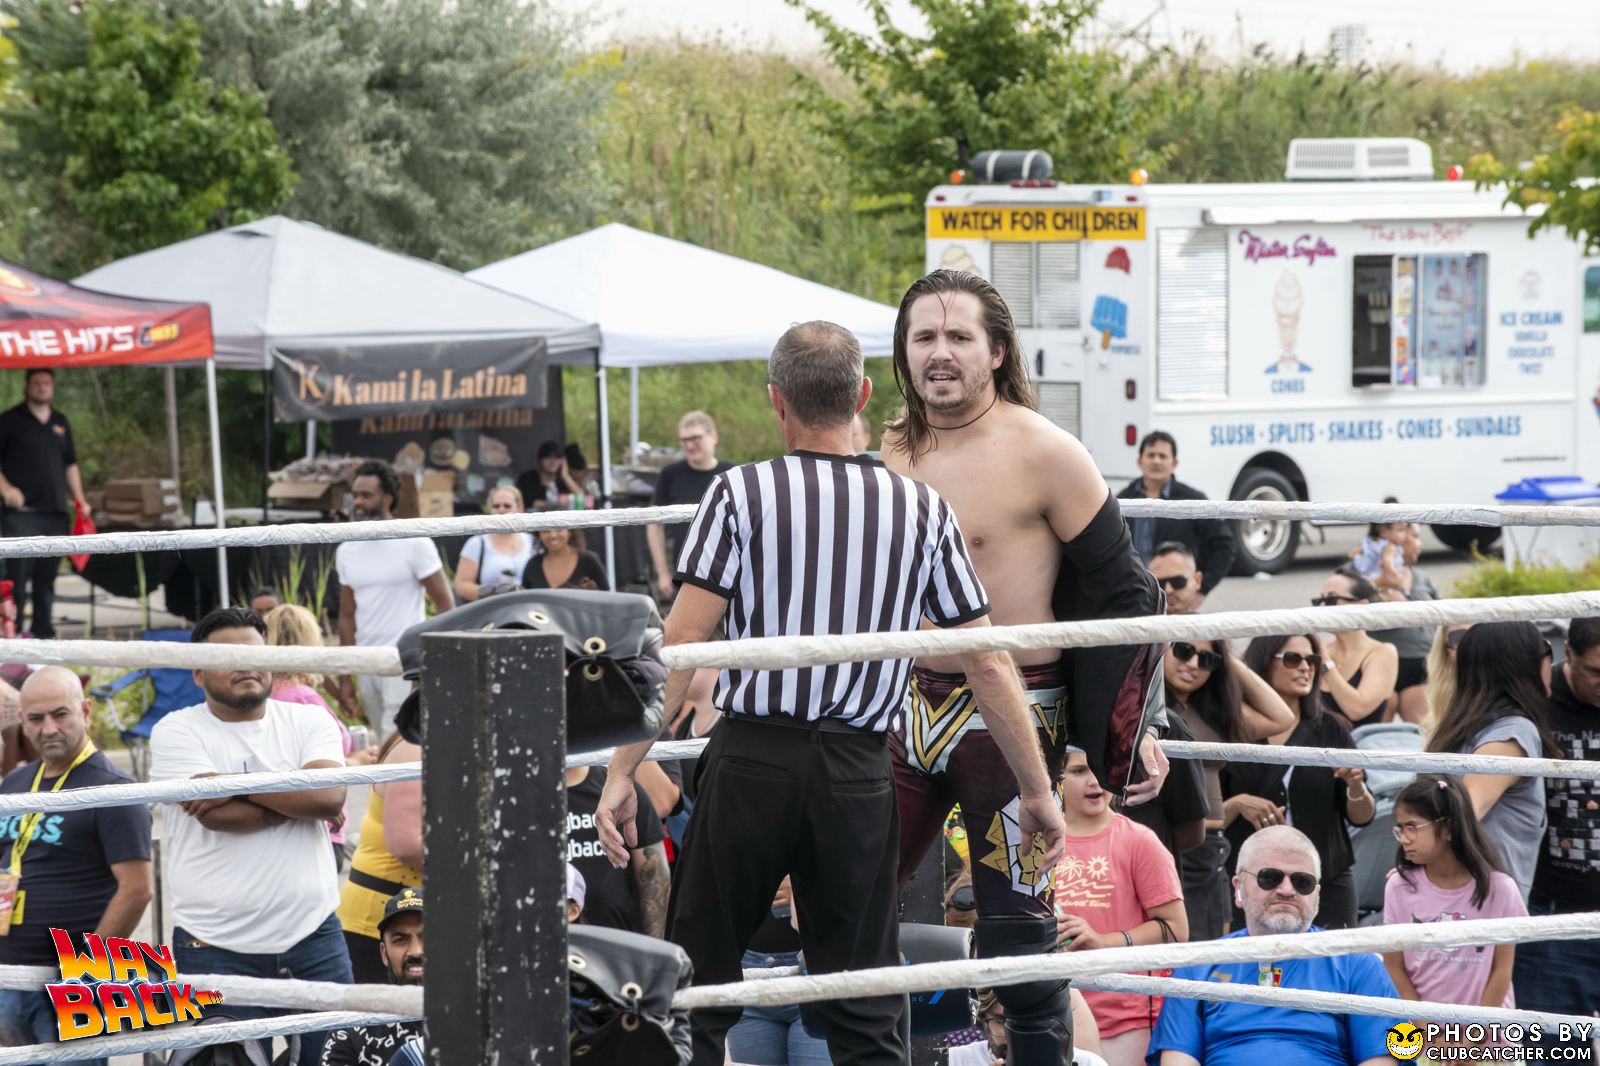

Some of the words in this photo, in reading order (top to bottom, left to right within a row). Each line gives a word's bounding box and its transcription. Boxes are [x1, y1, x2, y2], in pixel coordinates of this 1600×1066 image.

[942, 211, 1002, 231] WATCH
[1011, 211, 1047, 231] FOR
[1053, 211, 1139, 231] CHILDREN
[0, 329, 62, 357] THE
[62, 325, 134, 354] HITS
[332, 369, 407, 406] Kami
[410, 368, 437, 401] la
[442, 365, 527, 400] Latina
[1271, 379, 1305, 394] CONES
[1210, 424, 1255, 446] SLUSH
[1268, 422, 1315, 444] SPLITS
[1328, 420, 1383, 442] SHAKES
[1396, 418, 1443, 440] CONES
[1456, 415, 1522, 437] SUNDAES
